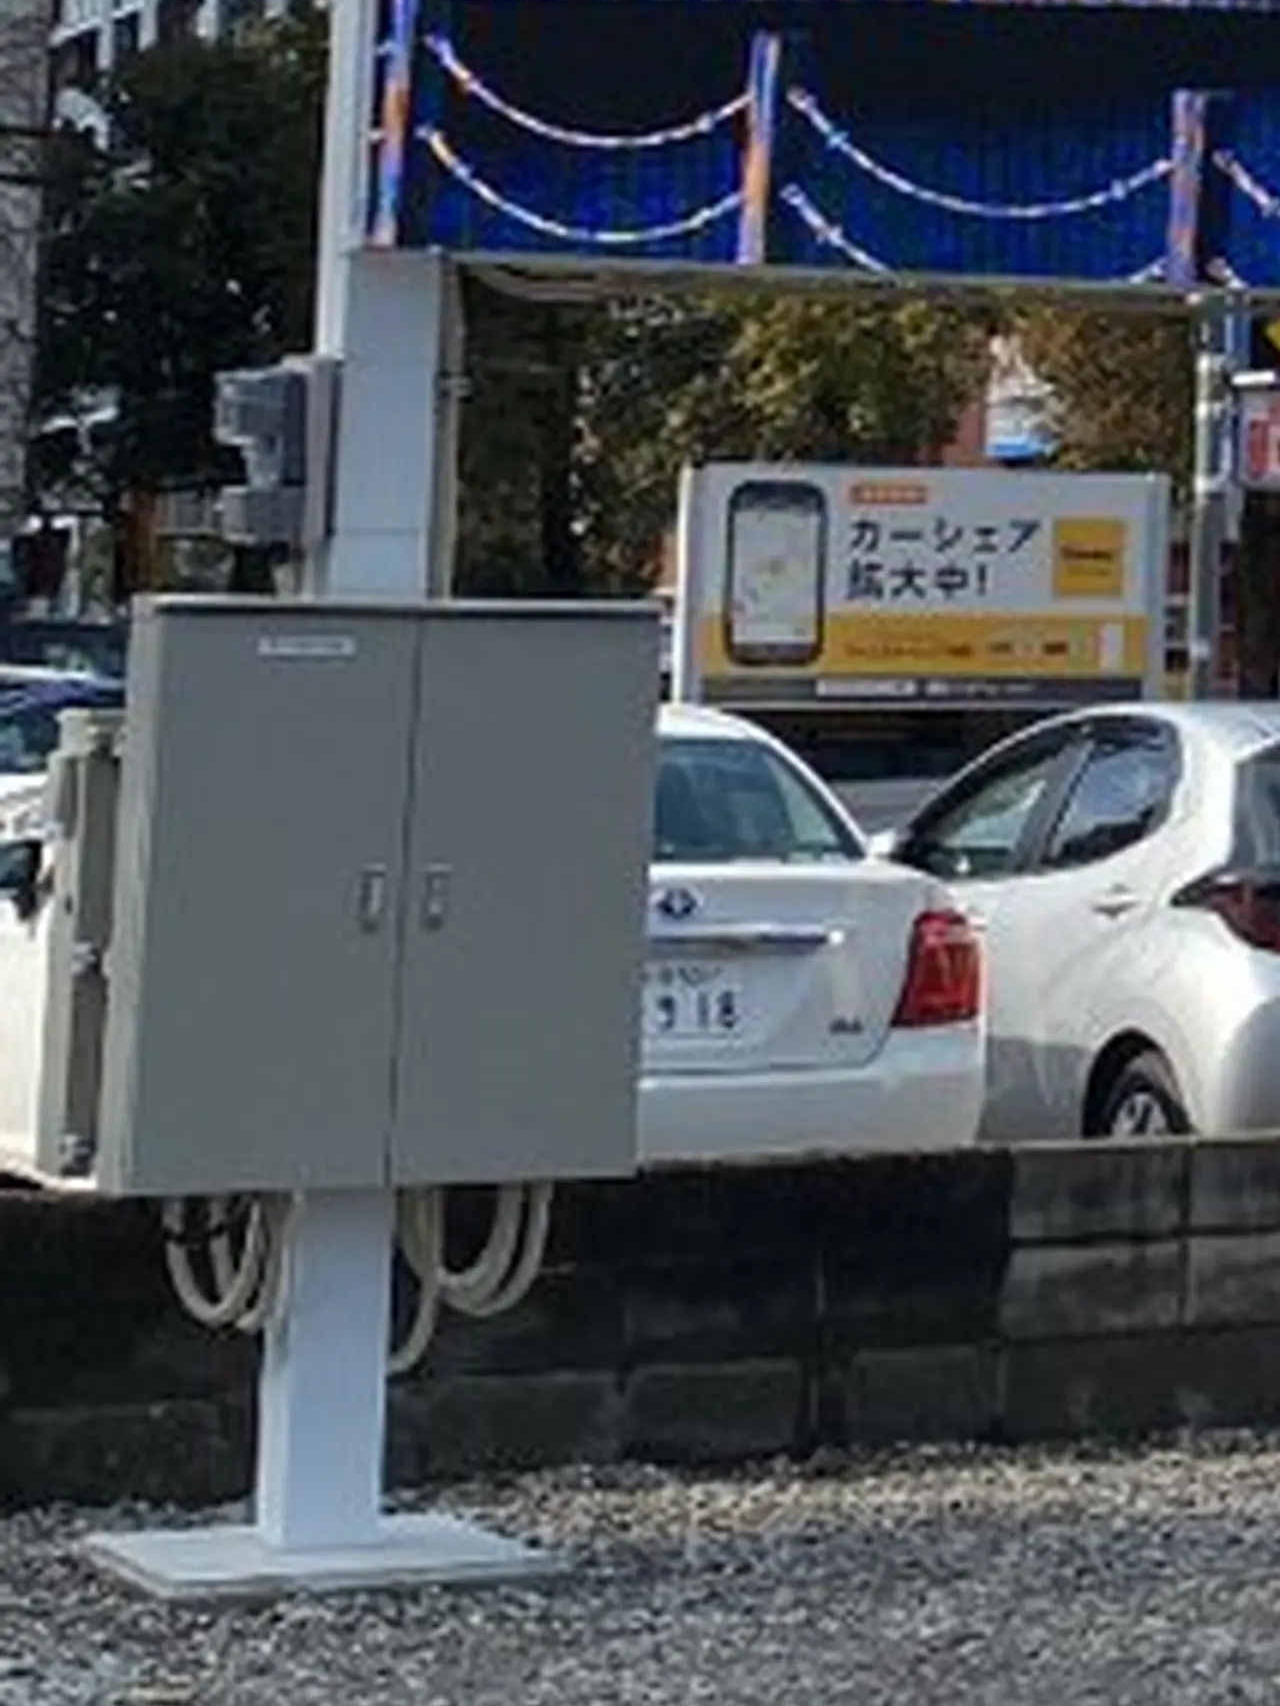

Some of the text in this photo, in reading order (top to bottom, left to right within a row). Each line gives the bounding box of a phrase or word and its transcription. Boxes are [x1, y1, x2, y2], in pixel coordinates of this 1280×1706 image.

[849, 517, 1041, 555] カーシェア
[847, 558, 989, 600] 拡大中!
